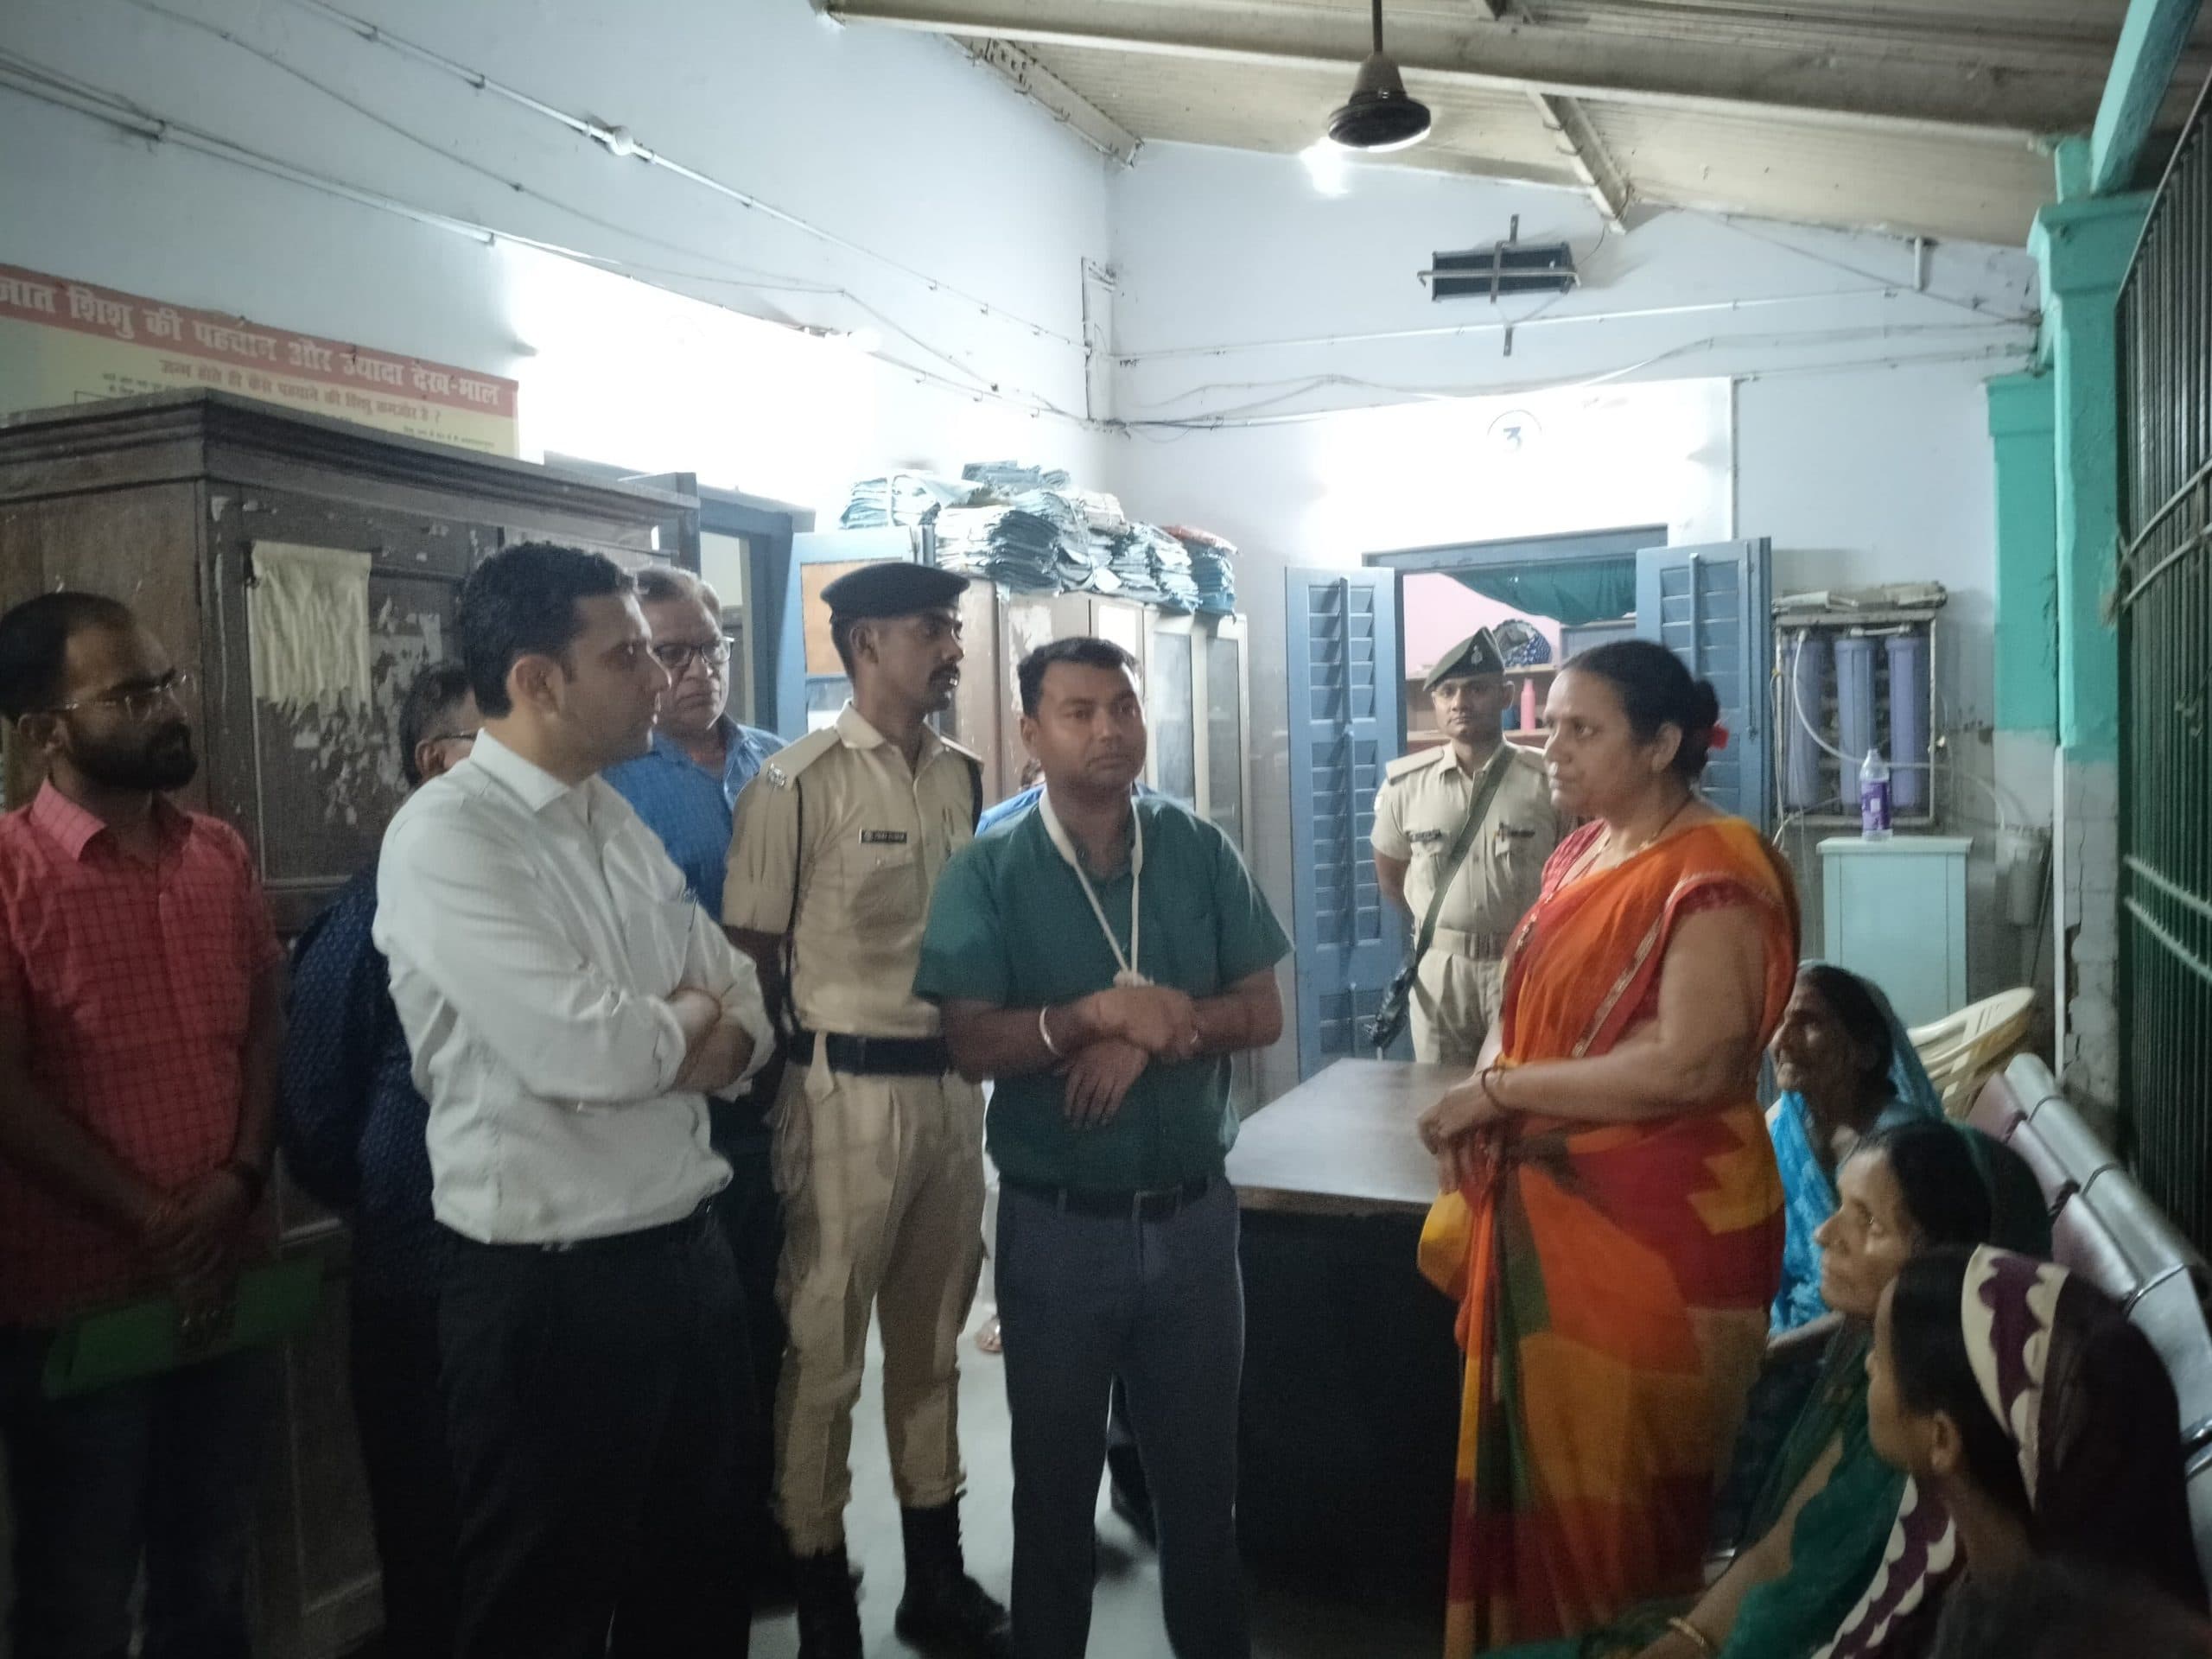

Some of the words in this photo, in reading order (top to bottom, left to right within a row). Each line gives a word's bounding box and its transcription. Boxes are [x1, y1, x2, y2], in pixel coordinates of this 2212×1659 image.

[67, 283, 135, 339] शिशु
[143, 306, 181, 341] की
[192, 321, 277, 361] पहचान
[289, 338, 332, 372] और
[411, 363, 500, 406] देख-भाल
